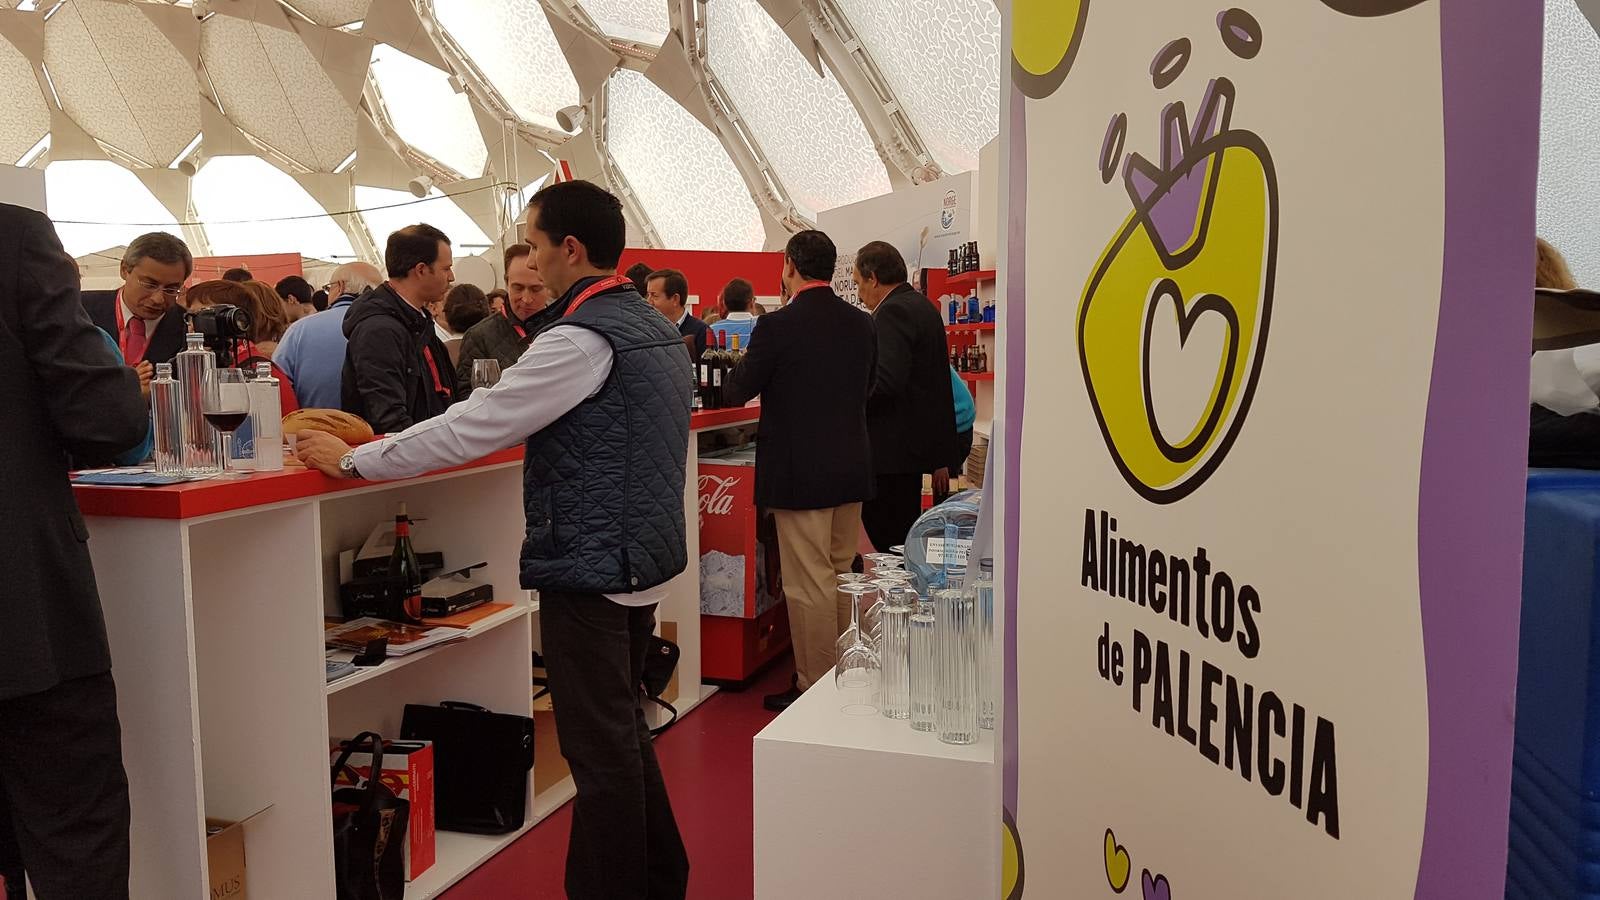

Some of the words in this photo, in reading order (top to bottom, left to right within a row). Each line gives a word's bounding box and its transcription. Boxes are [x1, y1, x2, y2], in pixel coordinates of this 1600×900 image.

[834, 279, 858, 291] NORUE
[1081, 508, 1261, 658] Alimentos
[1098, 621, 1124, 686] de
[1132, 629, 1340, 840] PALENCIA
